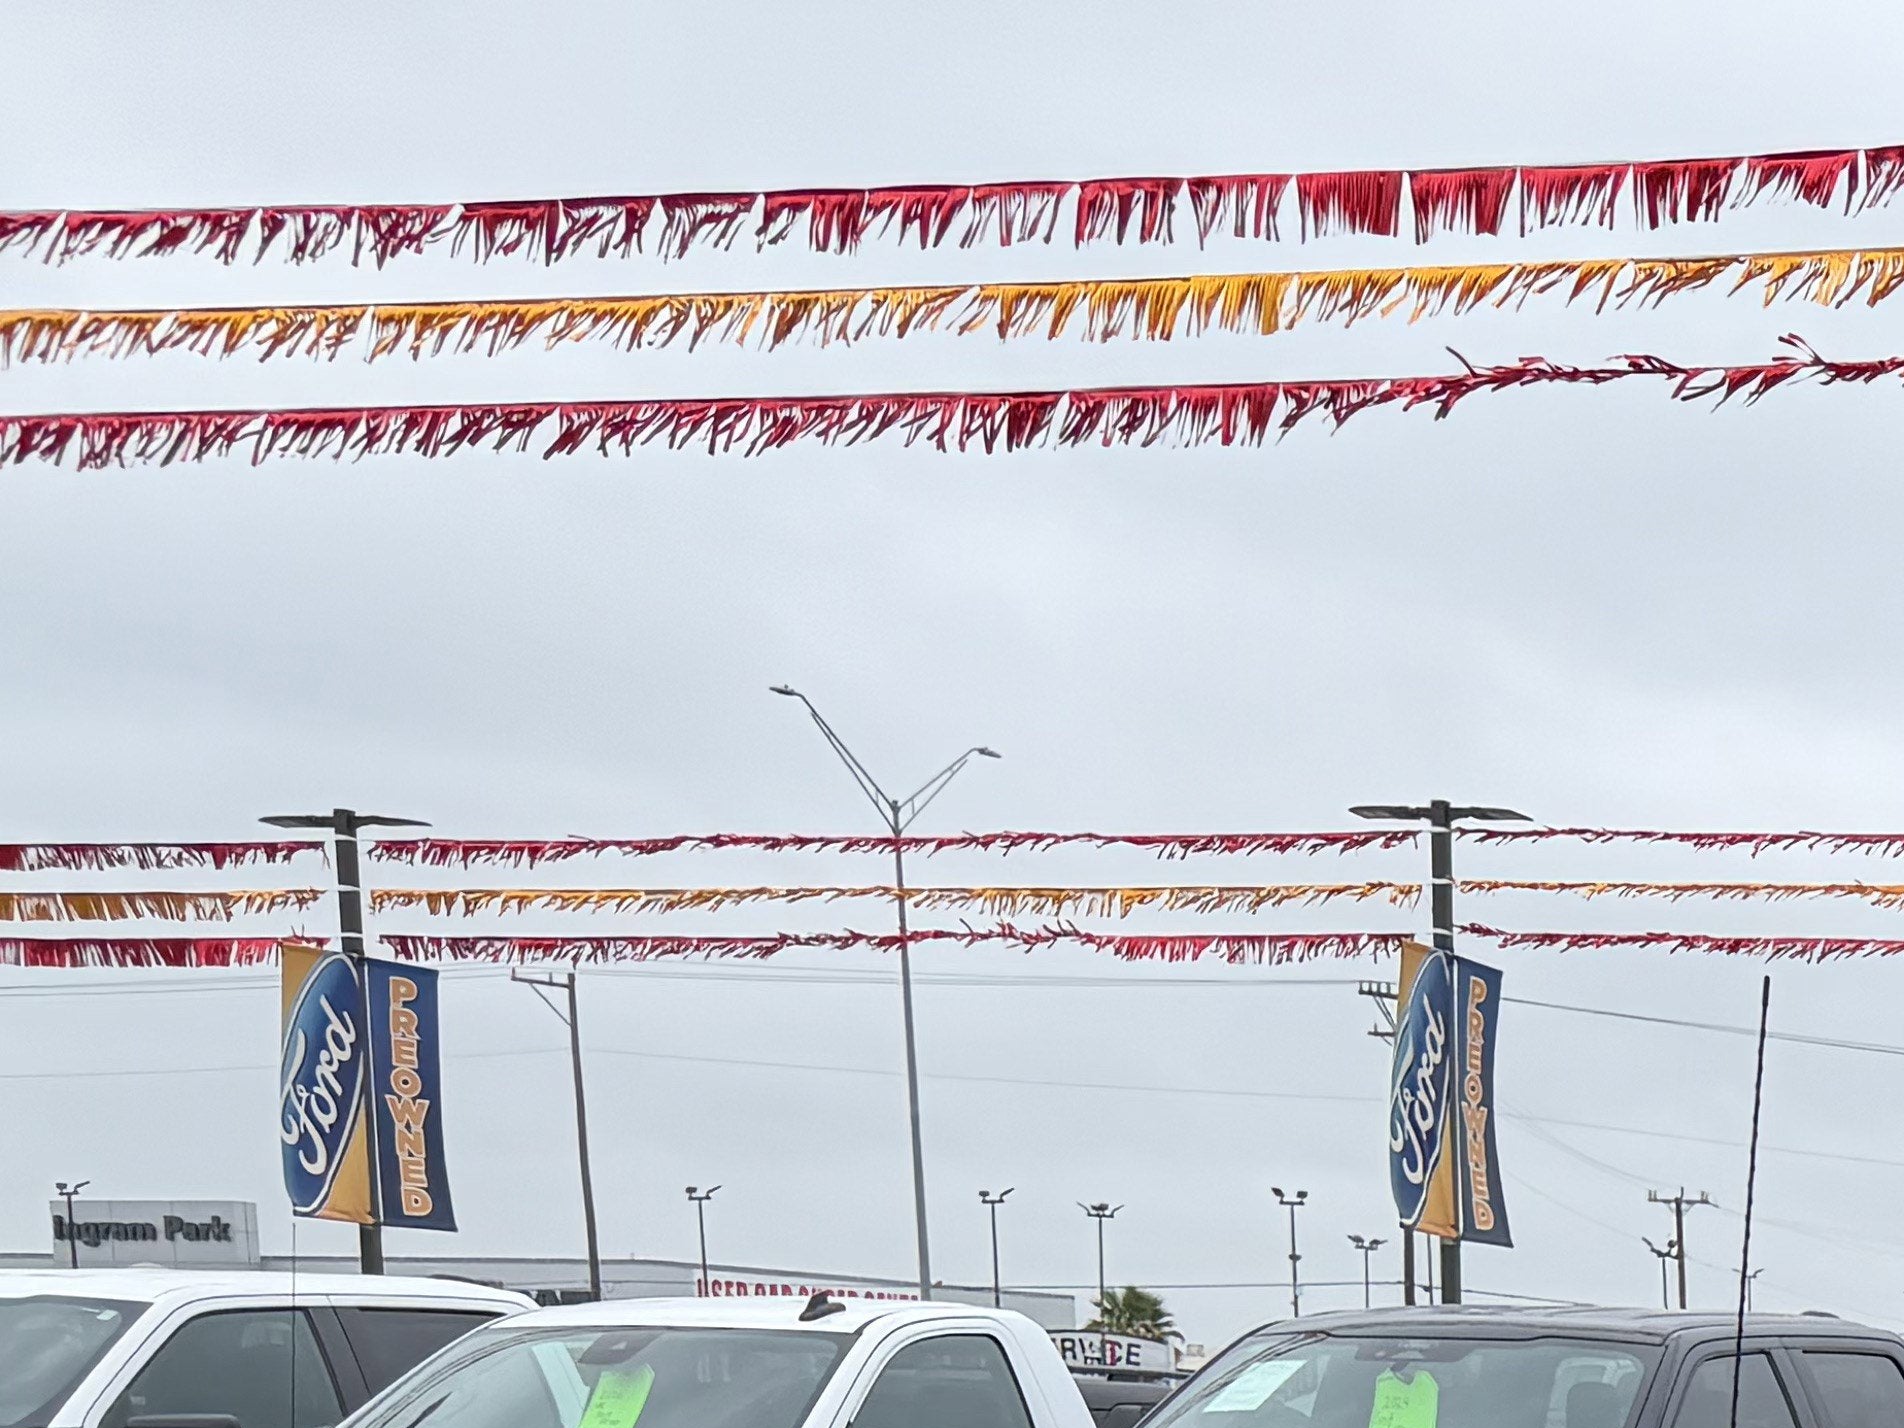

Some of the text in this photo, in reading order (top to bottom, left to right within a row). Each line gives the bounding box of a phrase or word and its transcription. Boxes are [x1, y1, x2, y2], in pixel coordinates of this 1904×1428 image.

[281, 994, 357, 1176] Ford
[385, 975, 433, 1217] PREOWNED
[1390, 992, 1446, 1185] Ford
[1461, 975, 1495, 1231] PREOWNED
[163, 1214, 232, 1242] Park
